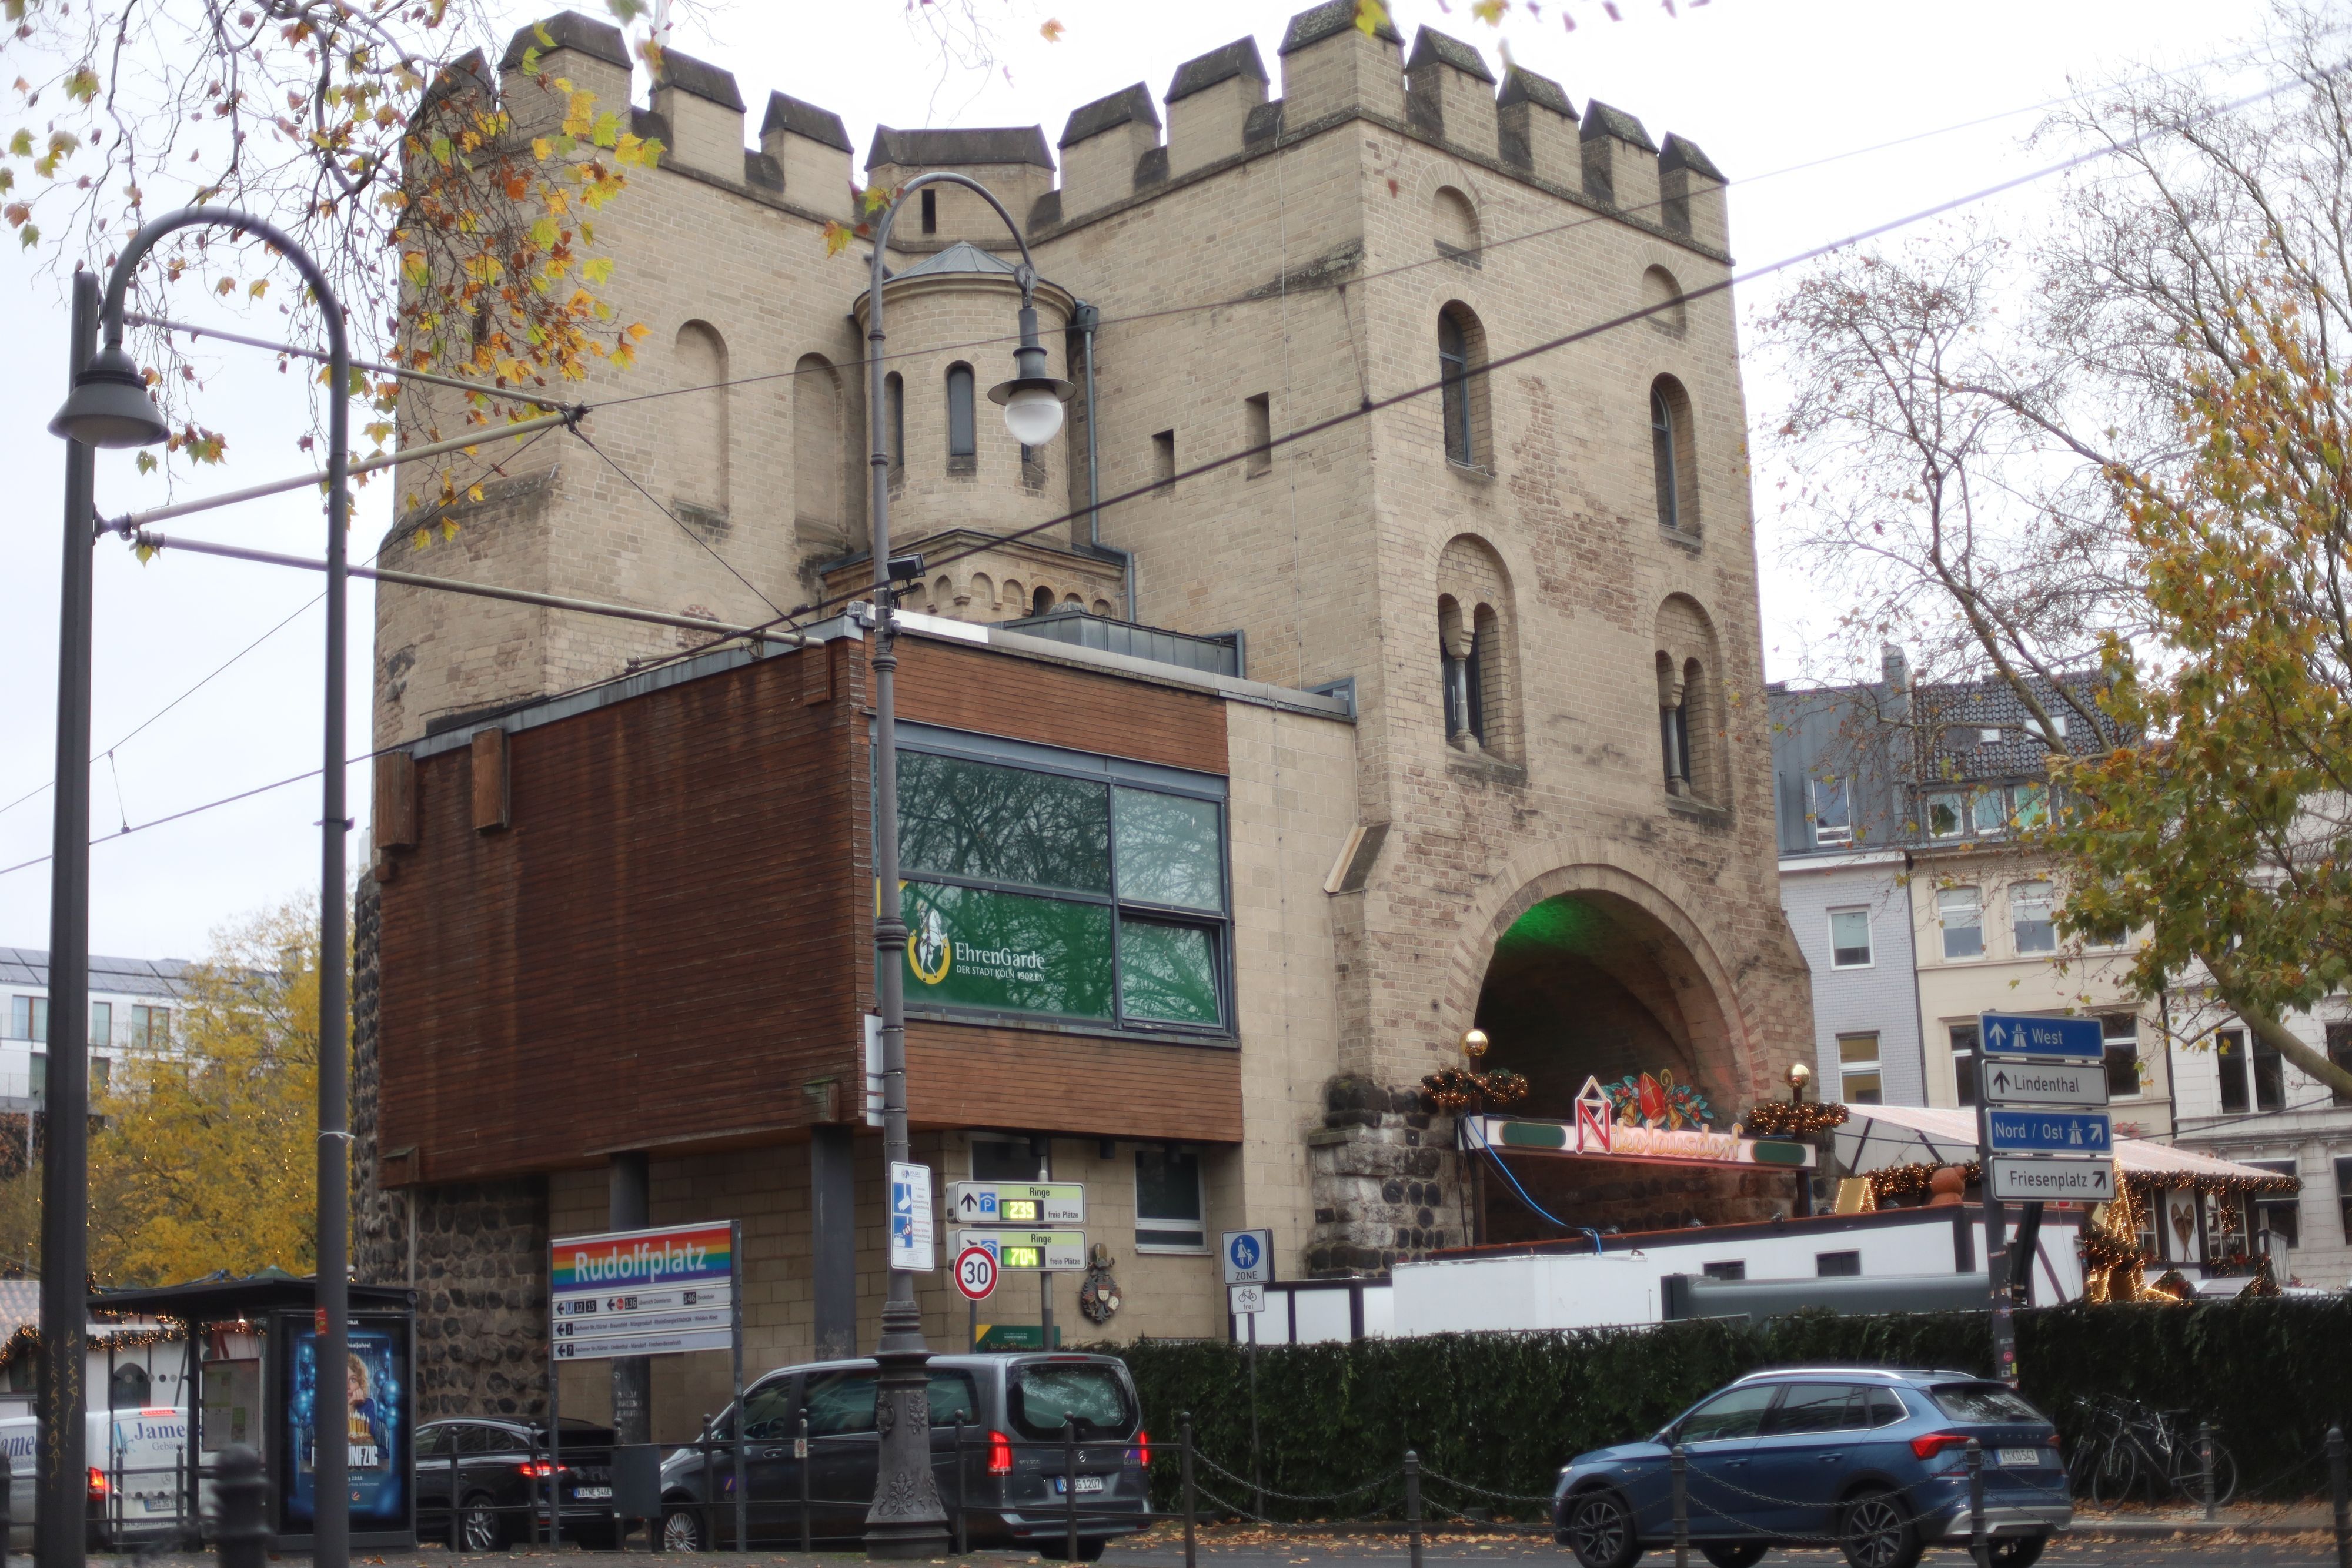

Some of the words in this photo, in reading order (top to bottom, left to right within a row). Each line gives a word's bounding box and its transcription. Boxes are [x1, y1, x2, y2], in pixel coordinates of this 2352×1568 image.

[955, 942, 1045, 969] EhrenGarde
[957, 965, 970, 974] DER
[972, 966, 994, 977] STADT
[995, 968, 1015, 979] KÖLN
[1017, 971, 1033, 981] 1902
[2032, 1028, 2063, 1045] West
[2014, 1075, 2080, 1092] Lindenthal
[1576, 1098, 1745, 1160] Nikolausdorf
[1995, 1122, 2026, 1139] Nord
[2043, 1124, 2063, 1139] Ost
[2010, 1171, 2087, 1191] Friesenplatz
[1029, 1187, 1050, 1199] Ringe
[1010, 1201, 1035, 1219] 239
[1062, 1211, 1079, 1219] Plätze
[1031, 1233, 1052, 1245] Ringe
[575, 1241, 707, 1283] Rudolfplatz
[1011, 1248, 1037, 1265] 704
[964, 1261, 988, 1285] 30
[1235, 1271, 1258, 1281] ZONE
[626, 1298, 637, 1308] 136
[684, 1293, 696, 1303] 146
[576, 1303, 583, 1312] 12
[588, 1302, 595, 1311] 15
[1083, 1479, 1101, 1489] 1207
